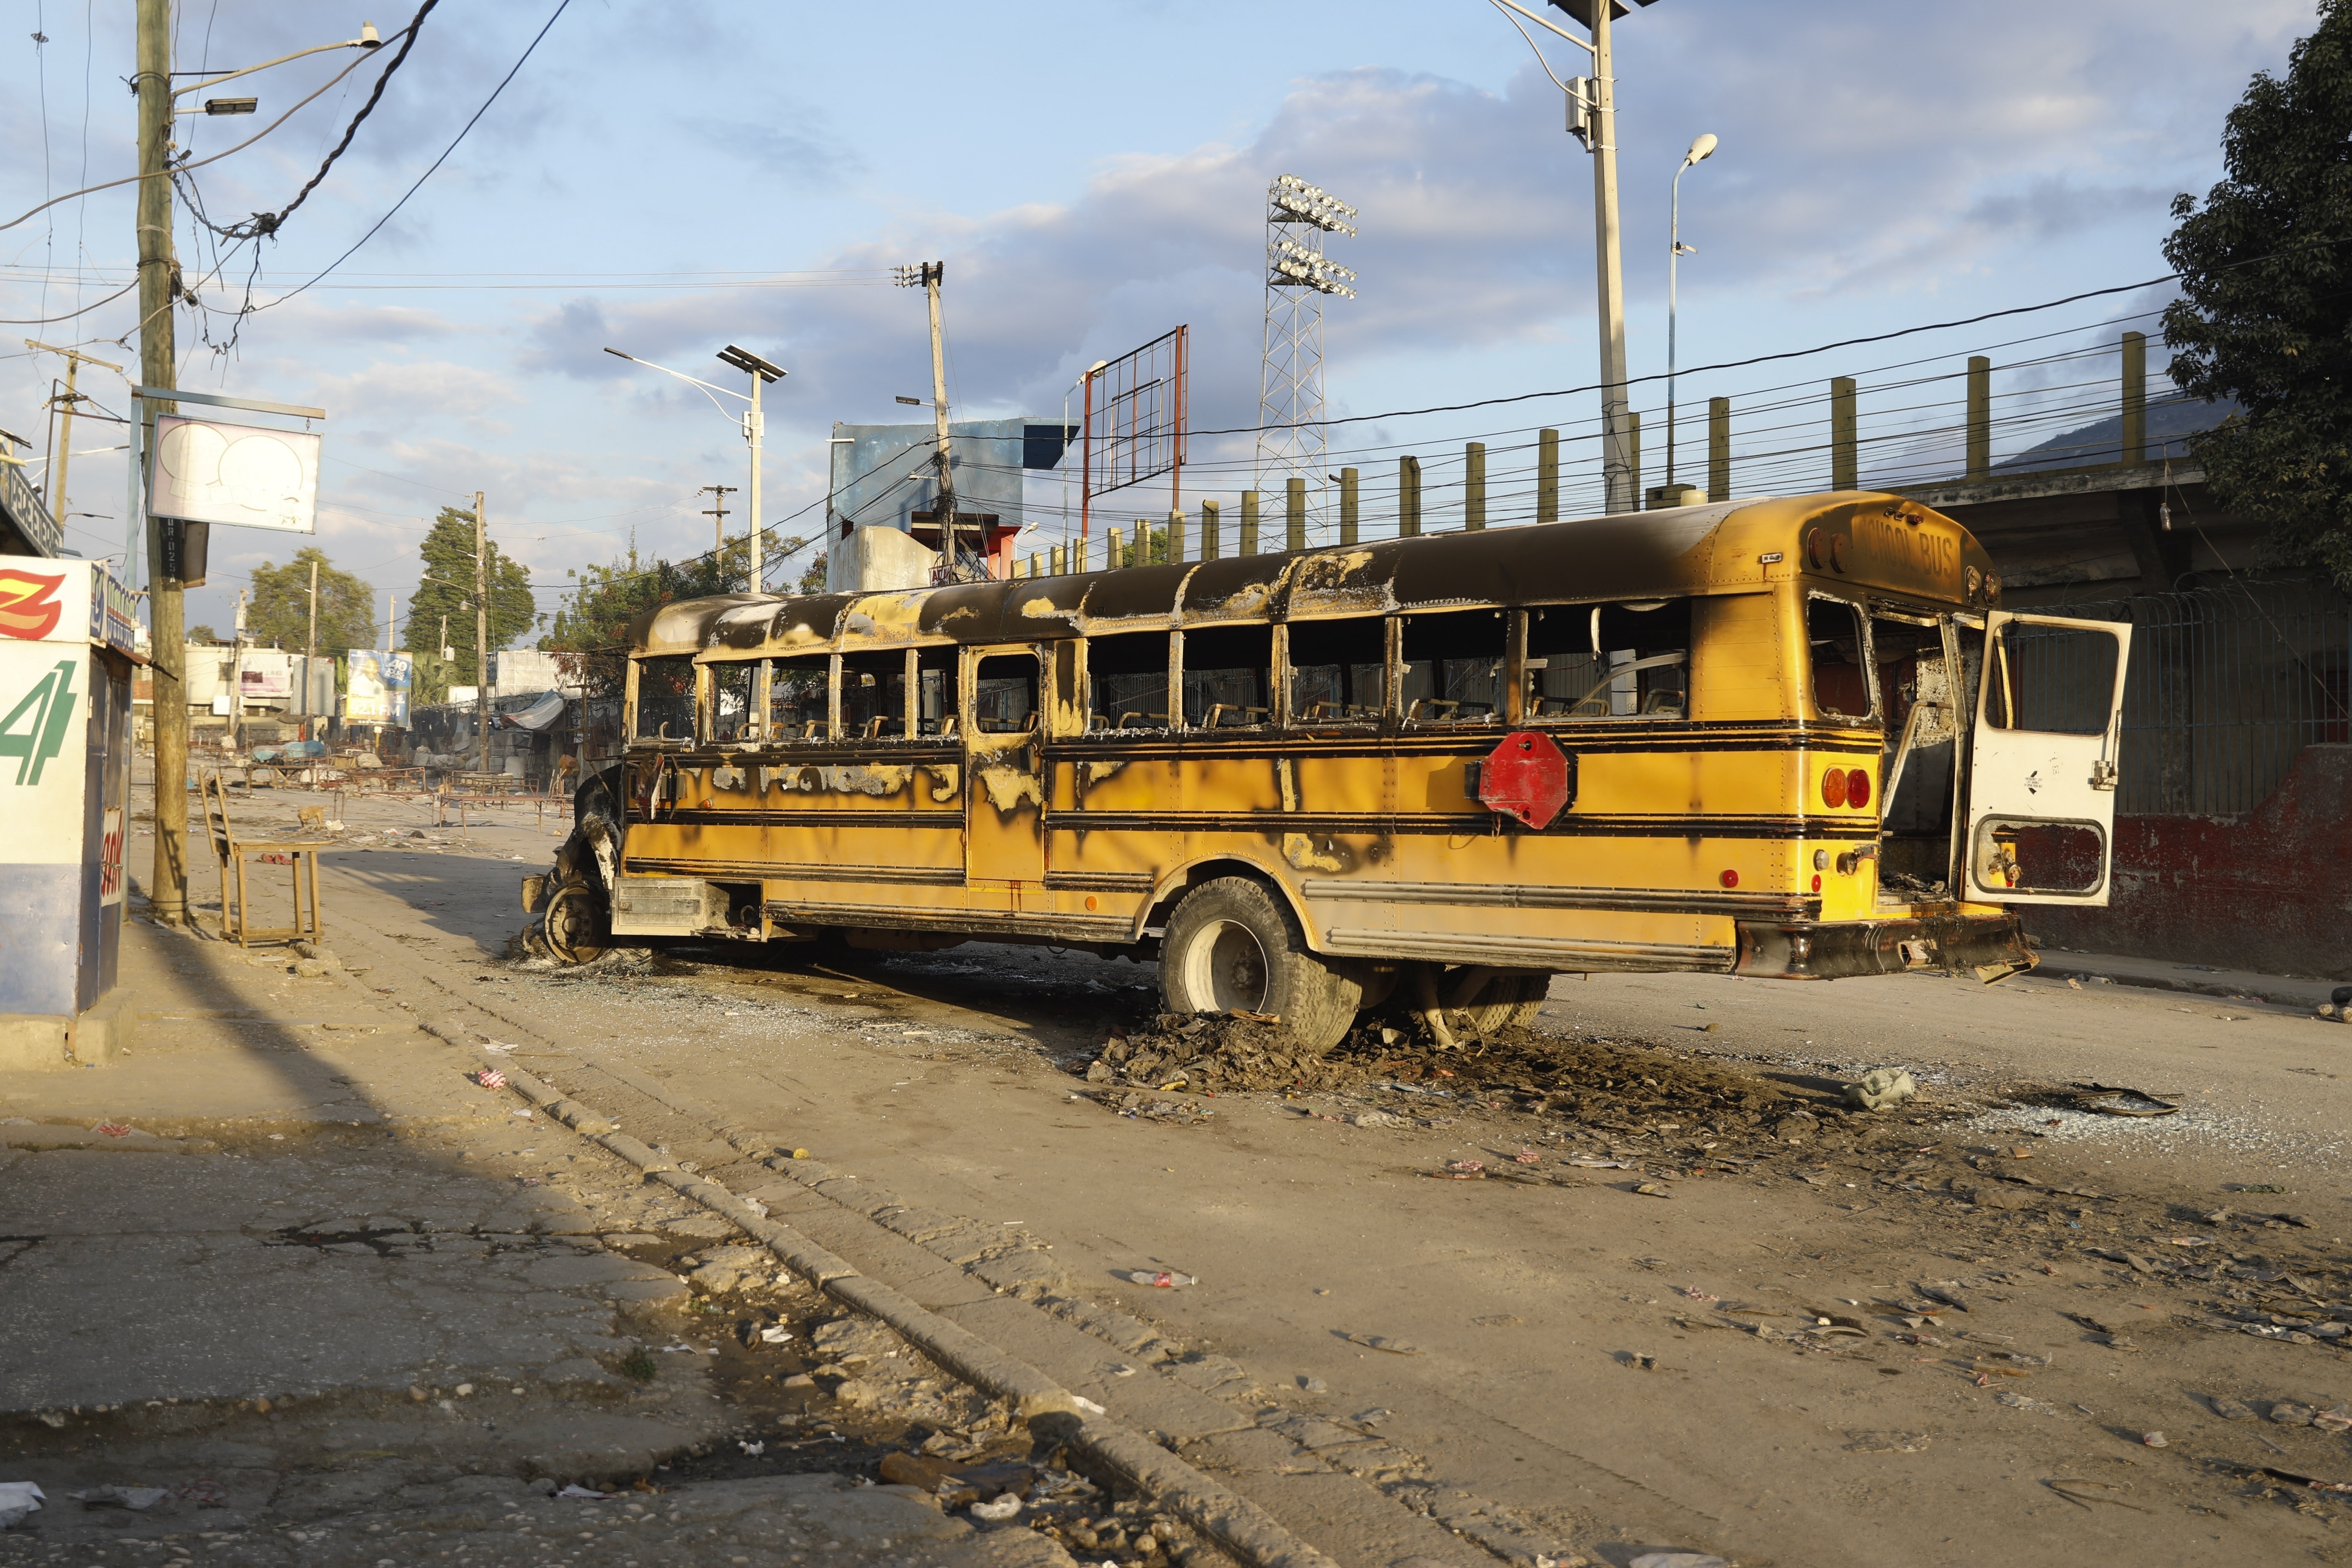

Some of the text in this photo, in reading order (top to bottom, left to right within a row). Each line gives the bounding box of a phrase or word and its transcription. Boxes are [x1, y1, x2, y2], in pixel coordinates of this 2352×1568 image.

[1860, 517, 1954, 579] CHOOL BUS
[389, 659, 407, 672] 40
[379, 704, 400, 717] FM
